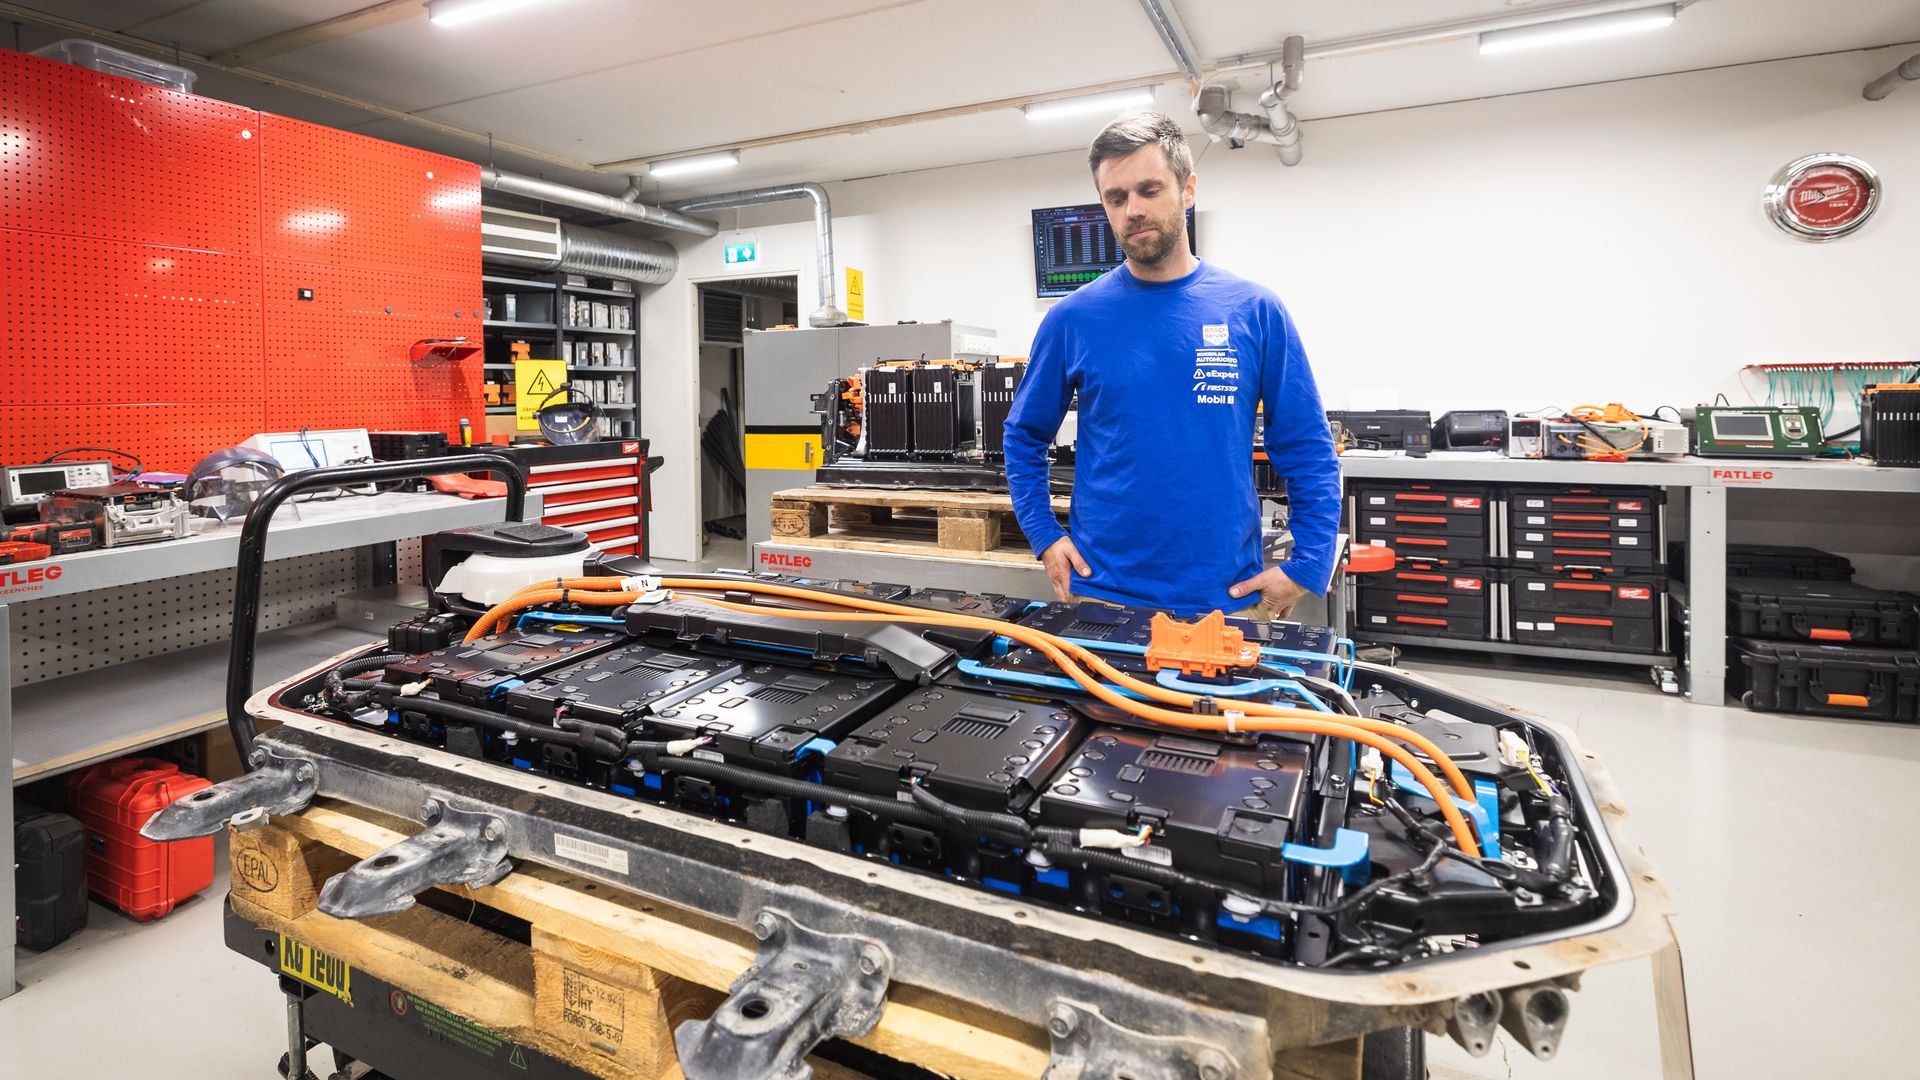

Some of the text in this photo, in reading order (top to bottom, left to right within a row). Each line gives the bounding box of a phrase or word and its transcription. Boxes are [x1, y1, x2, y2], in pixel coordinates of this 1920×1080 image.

[1206, 370, 1239, 379] eExpert
[1197, 394, 1226, 404] Mobil
[243, 854, 273, 886] EPAL
